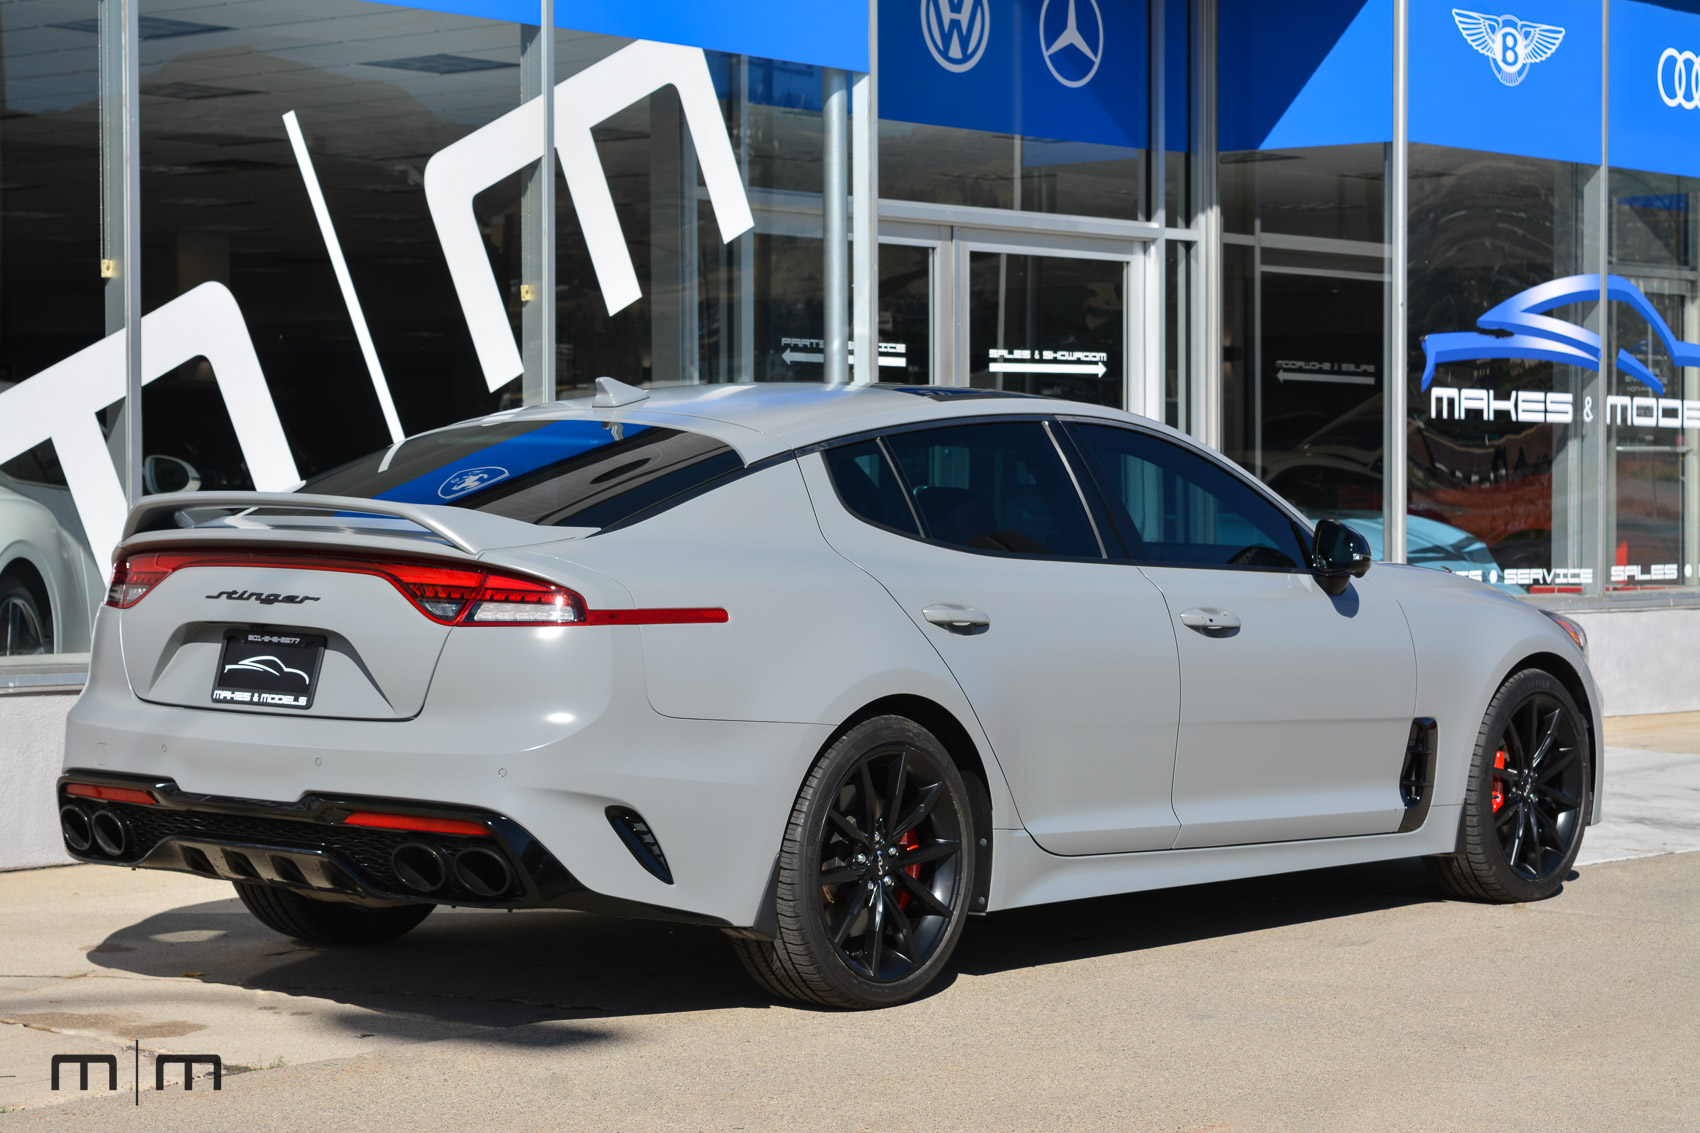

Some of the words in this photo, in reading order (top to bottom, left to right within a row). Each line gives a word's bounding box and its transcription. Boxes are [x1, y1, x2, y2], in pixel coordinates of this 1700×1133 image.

[988, 349, 1031, 360] SALES
[1034, 350, 1040, 360] &
[1042, 350, 1107, 361] SHOWROOM
[1430, 386, 1574, 424] MAKES
[1583, 396, 1594, 423] &
[1503, 568, 1594, 585] SERVICE
[1610, 564, 1679, 582] SALES
[213, 689, 252, 702] MAKES
[252, 692, 260, 702] &
[260, 693, 308, 706] MODELS
